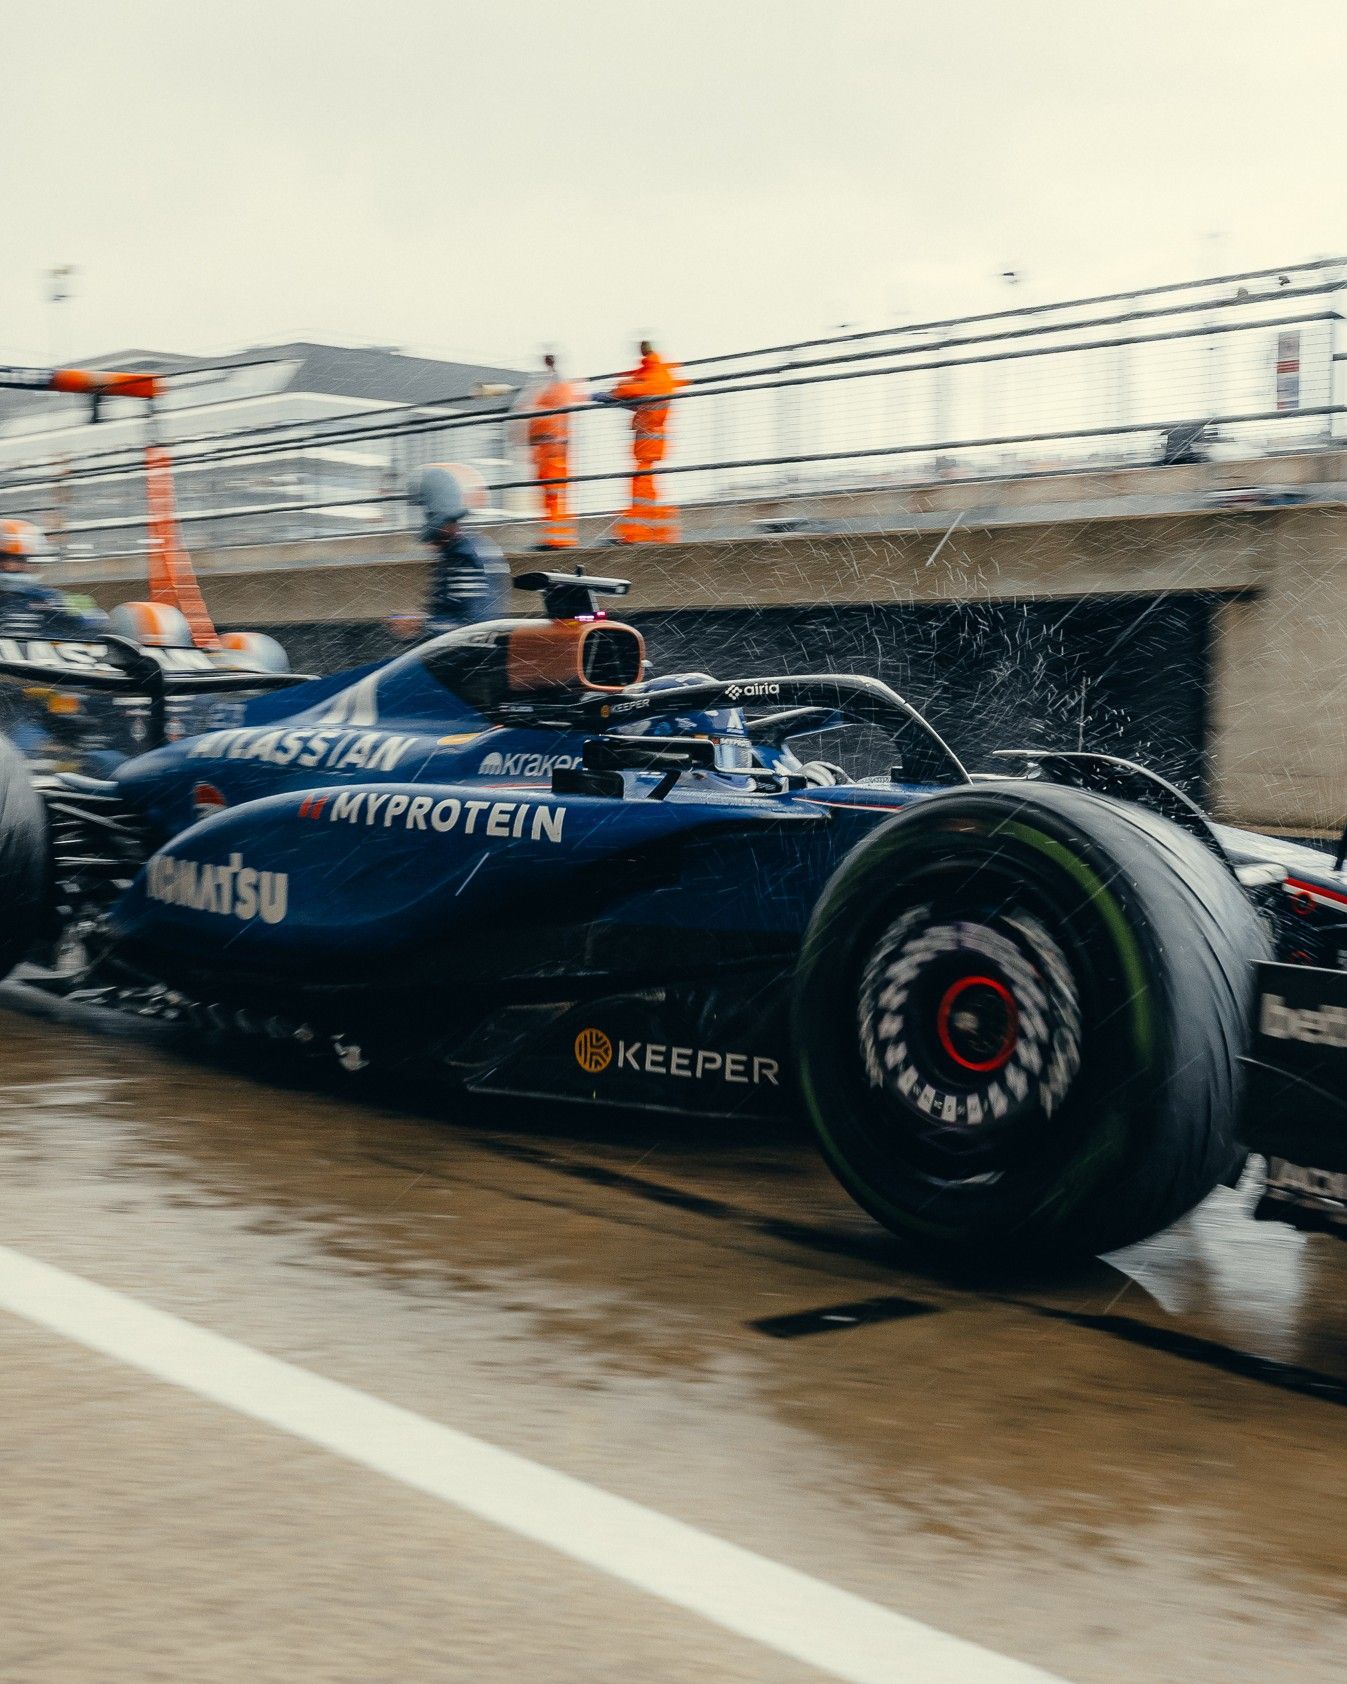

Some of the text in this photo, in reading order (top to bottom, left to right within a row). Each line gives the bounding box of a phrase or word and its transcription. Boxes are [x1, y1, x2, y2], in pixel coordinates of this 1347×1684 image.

[743, 682, 780, 696] airia
[329, 791, 566, 843] MYPROTEIN
[616, 1039, 780, 1086] KEEPER
